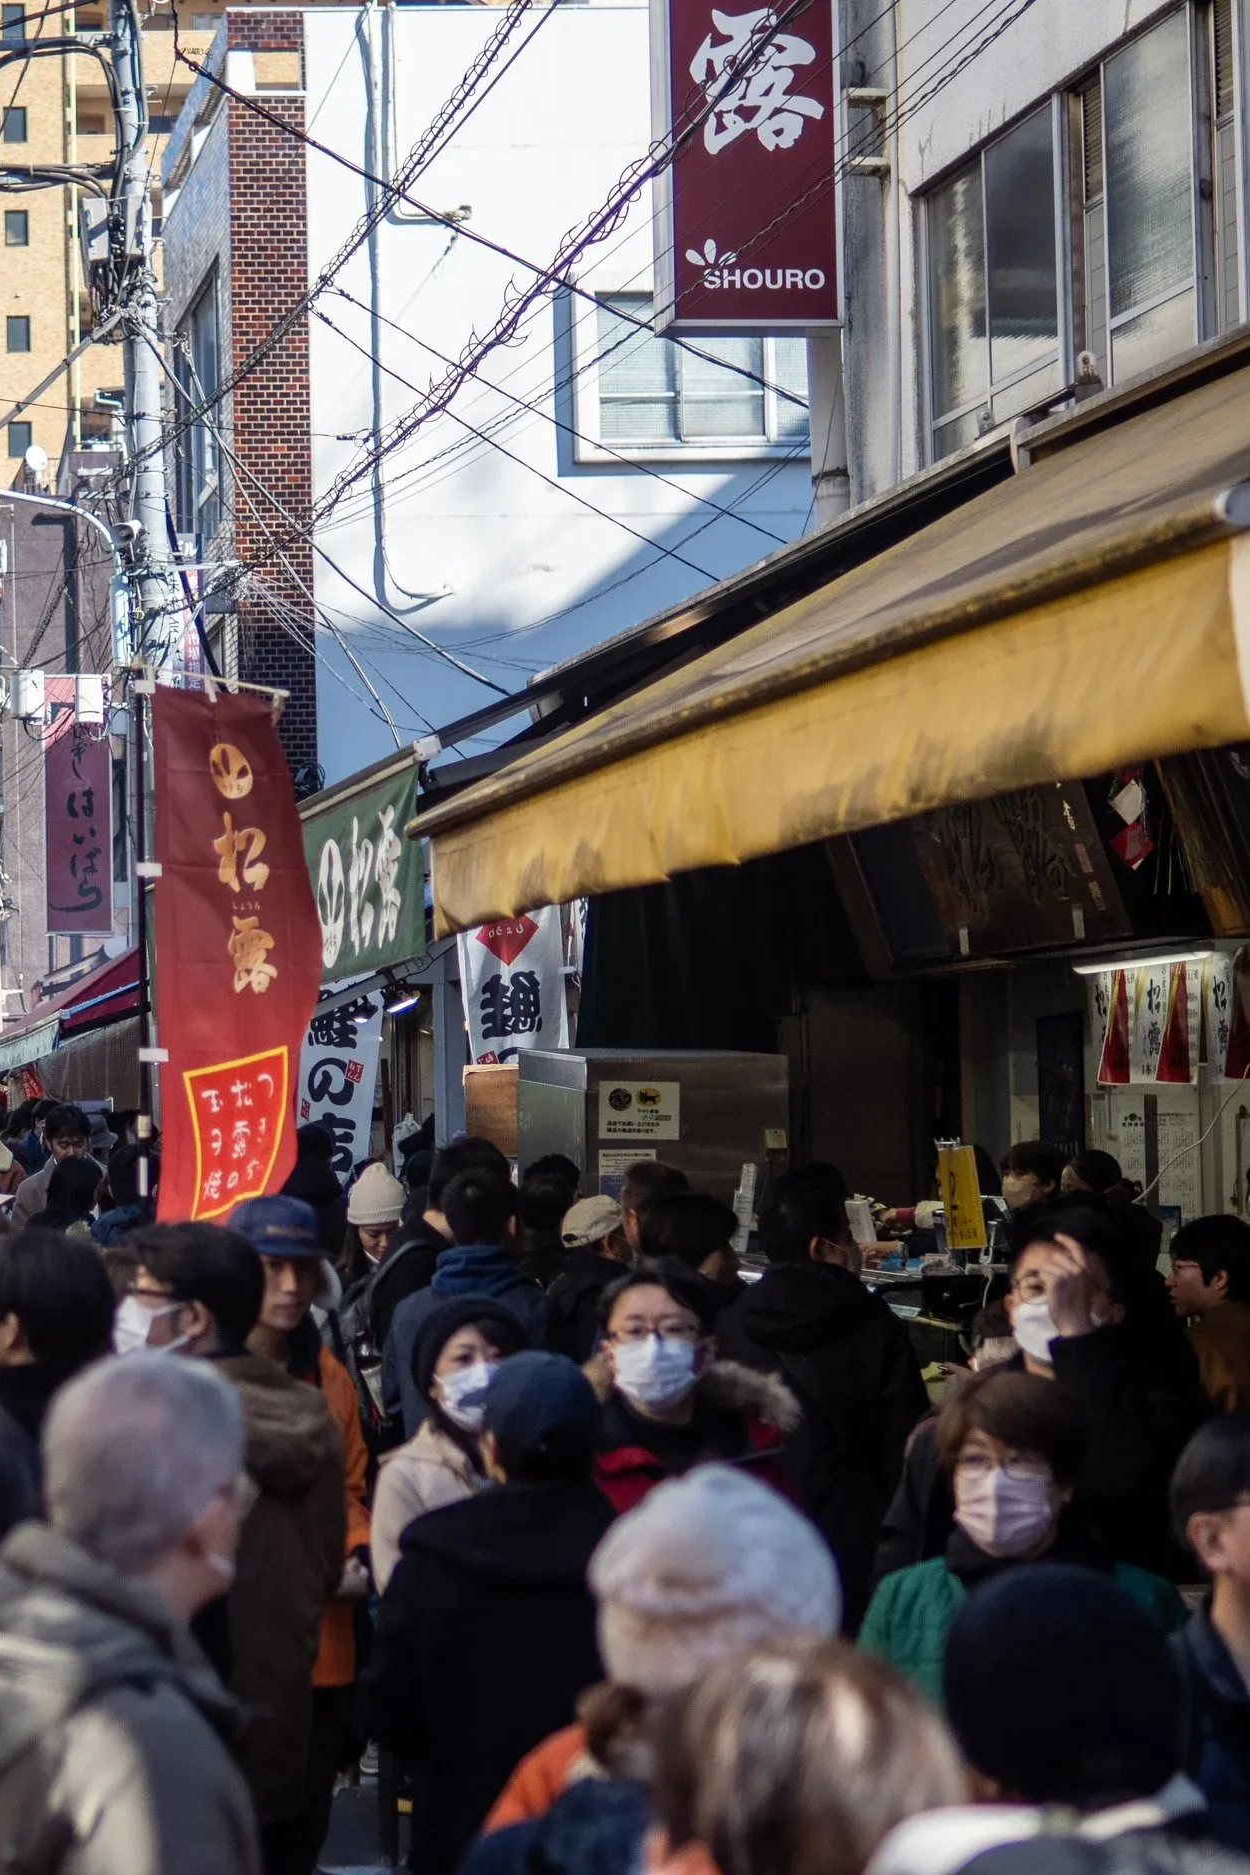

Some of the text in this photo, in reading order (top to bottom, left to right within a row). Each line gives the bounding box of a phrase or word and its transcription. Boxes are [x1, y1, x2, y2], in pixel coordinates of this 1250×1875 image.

[689, 7, 826, 155] 露
[703, 268, 826, 290] SHOURO
[349, 805, 402, 956] 松露
[201, 1089, 224, 1200] 玉子焼
[227, 1079, 253, 1189] 松露の
